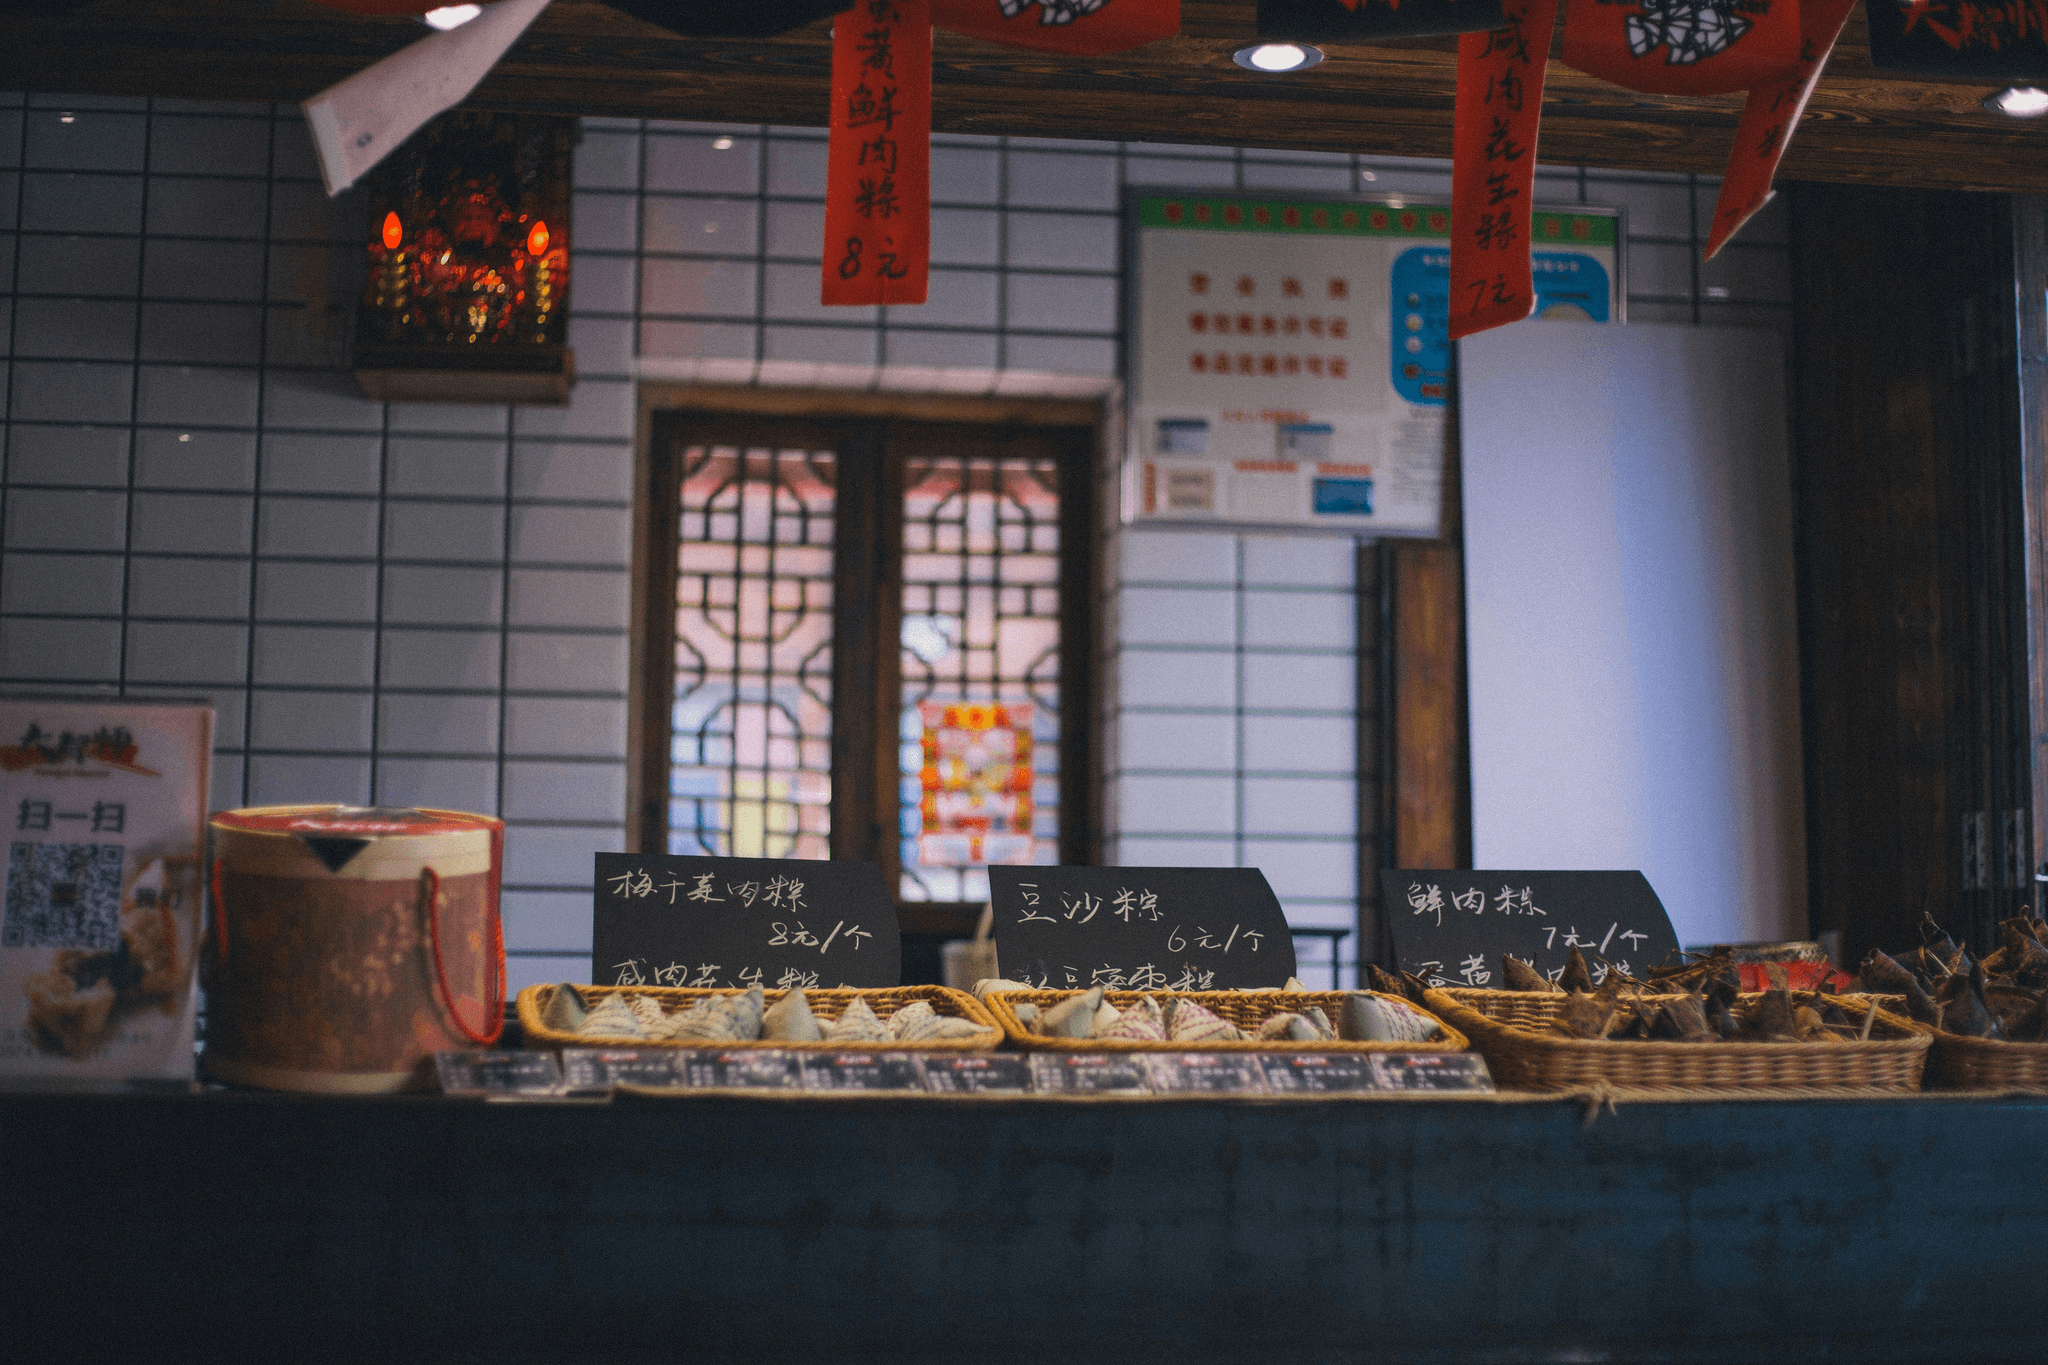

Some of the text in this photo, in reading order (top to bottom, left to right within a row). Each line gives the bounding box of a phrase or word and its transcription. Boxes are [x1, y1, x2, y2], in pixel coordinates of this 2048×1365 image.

[838, 236, 909, 280] 8元
[1468, 274, 1518, 315] 7元
[17, 798, 127, 834] 扫一扫
[607, 867, 808, 913] 梅干菜肉粽
[1017, 883, 1165, 924] 豆沙粽
[1407, 881, 1547, 927] 鲜肉粽
[767, 920, 873, 954] 8元/个
[1167, 924, 1265, 954] 6元/个
[1541, 922, 1650, 954] 7元/个
